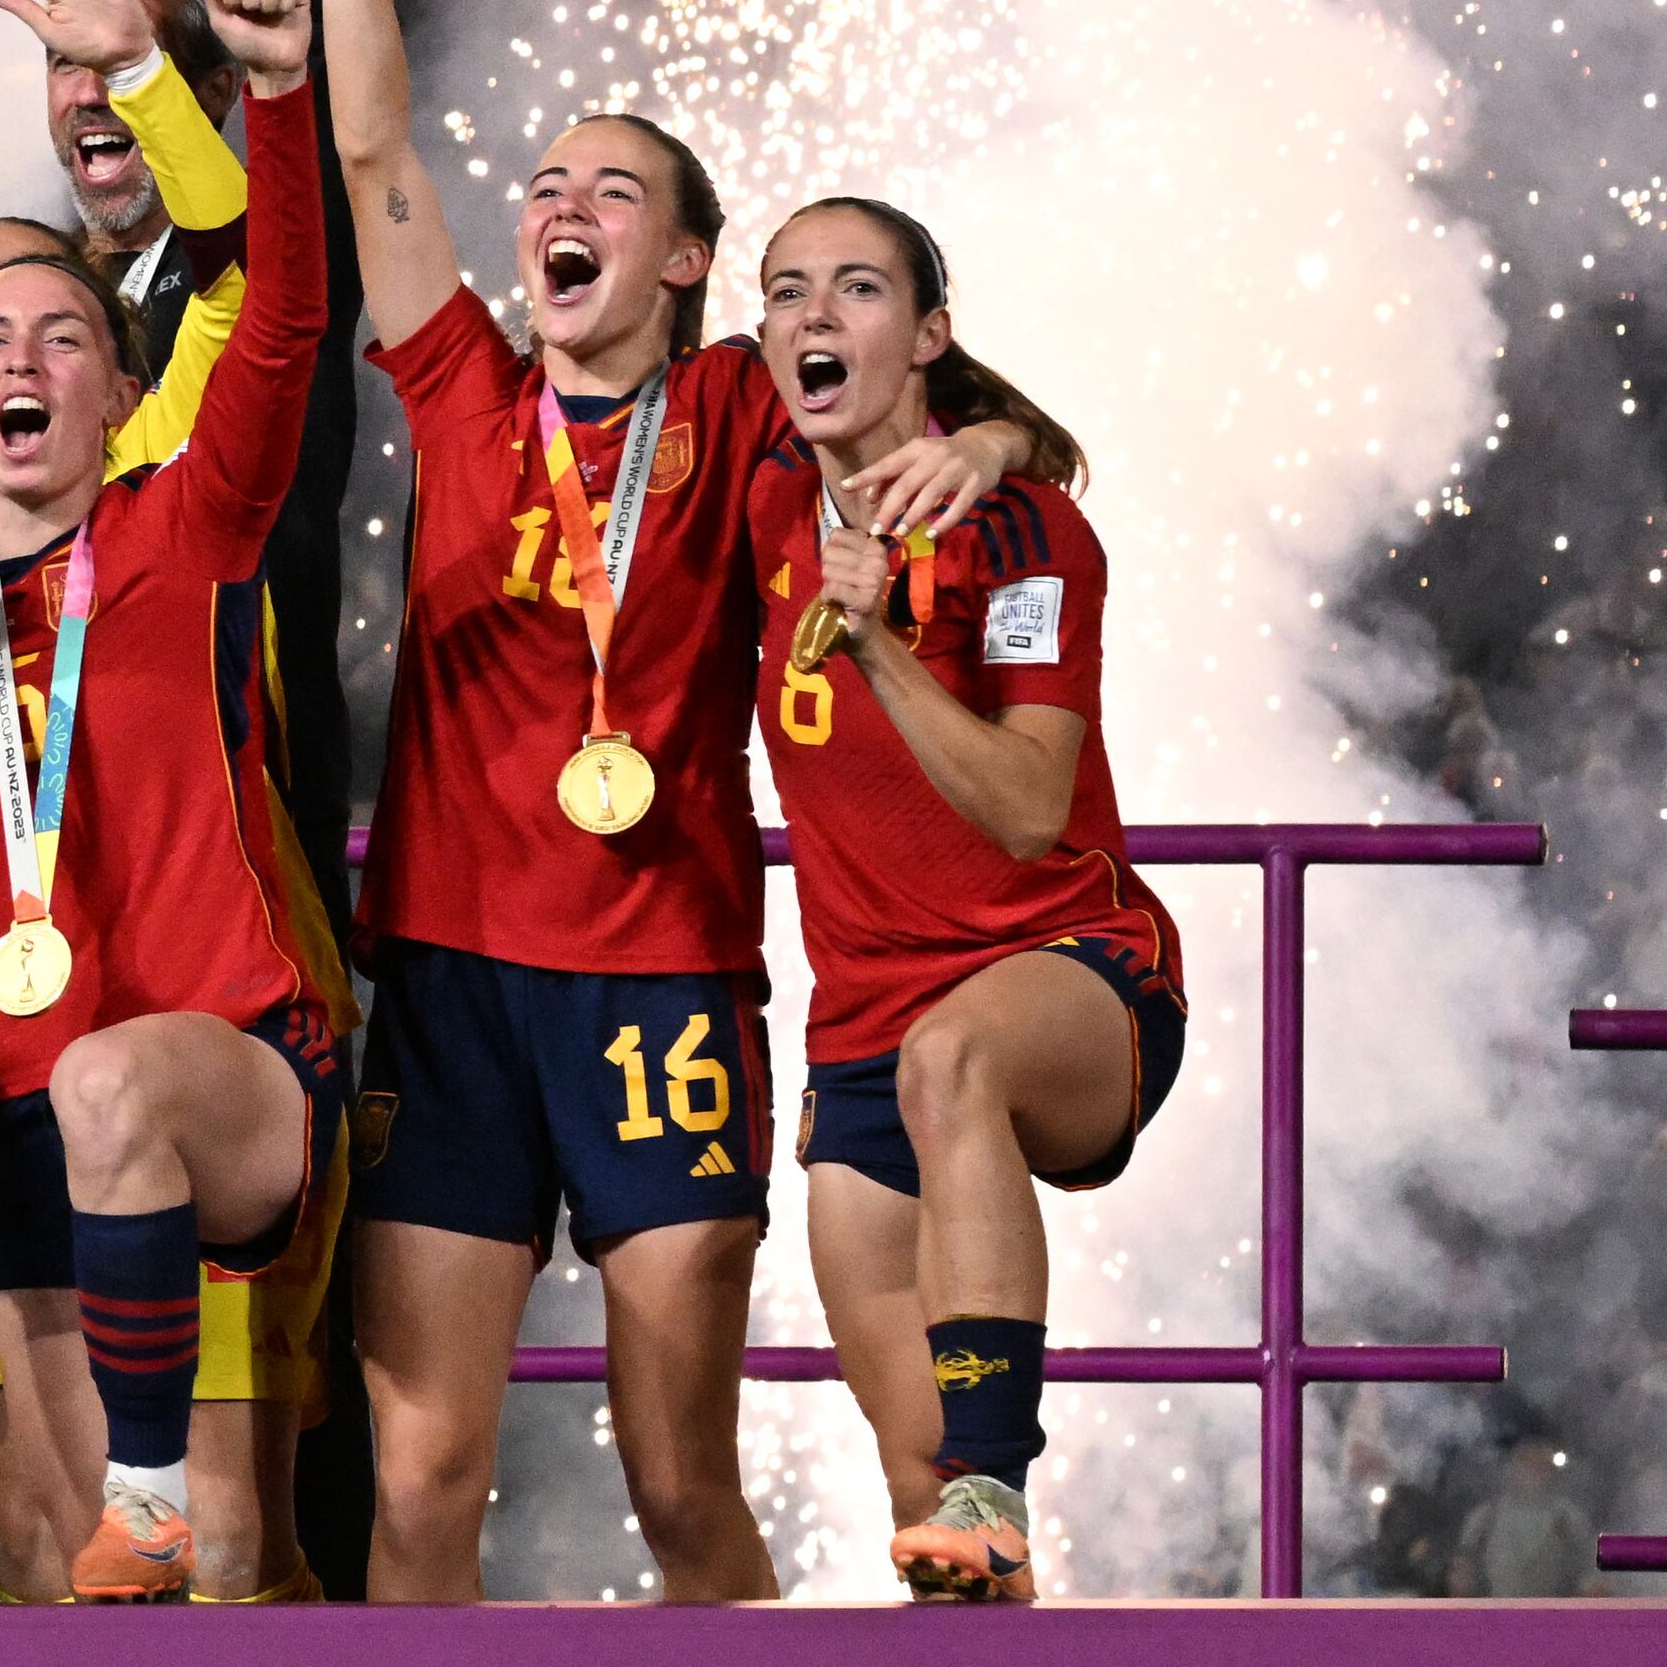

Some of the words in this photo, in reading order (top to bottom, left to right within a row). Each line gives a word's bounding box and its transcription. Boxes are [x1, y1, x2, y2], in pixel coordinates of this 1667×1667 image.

[621, 466, 641, 510] WORLD
[616, 512, 630, 538] CUP
[1001, 603, 1045, 620] UNITES
[1, 717, 15, 745] CUP
[604, 1014, 729, 1142] 16
